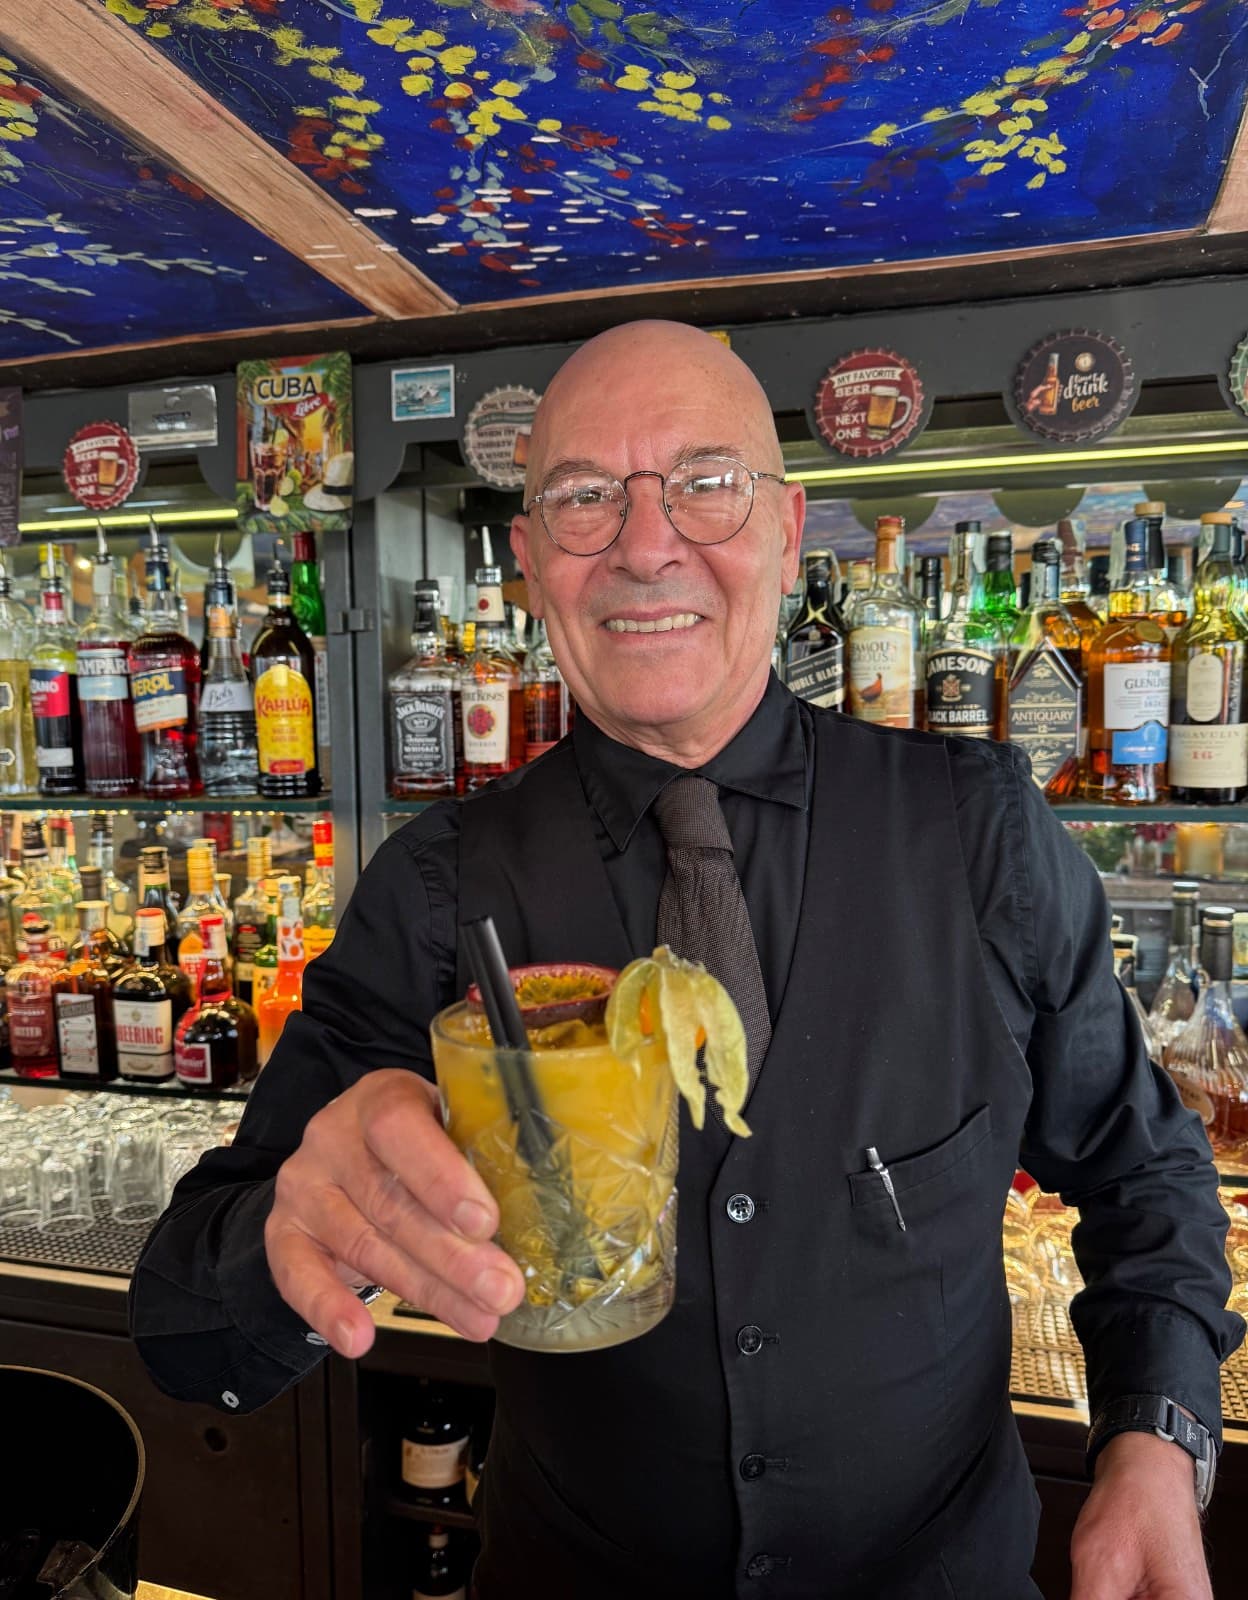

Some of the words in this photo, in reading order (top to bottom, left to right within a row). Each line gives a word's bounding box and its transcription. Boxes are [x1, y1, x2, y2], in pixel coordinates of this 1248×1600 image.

[837, 375, 850, 384] MY
[853, 369, 897, 381] FAVORITE
[258, 376, 317, 399] CUBA
[835, 384, 871, 398] BEER
[1063, 373, 1109, 400] drink
[1072, 396, 1099, 413] beer
[835, 412, 866, 426] NEXT
[836, 427, 861, 440] ONE
[77, 658, 129, 676] AMPAR
[927, 655, 993, 678] JAMESON
[396, 704, 415, 720] JACK
[948, 709, 989, 723] BARREL
[1011, 711, 1074, 722] ANTIQUARY
